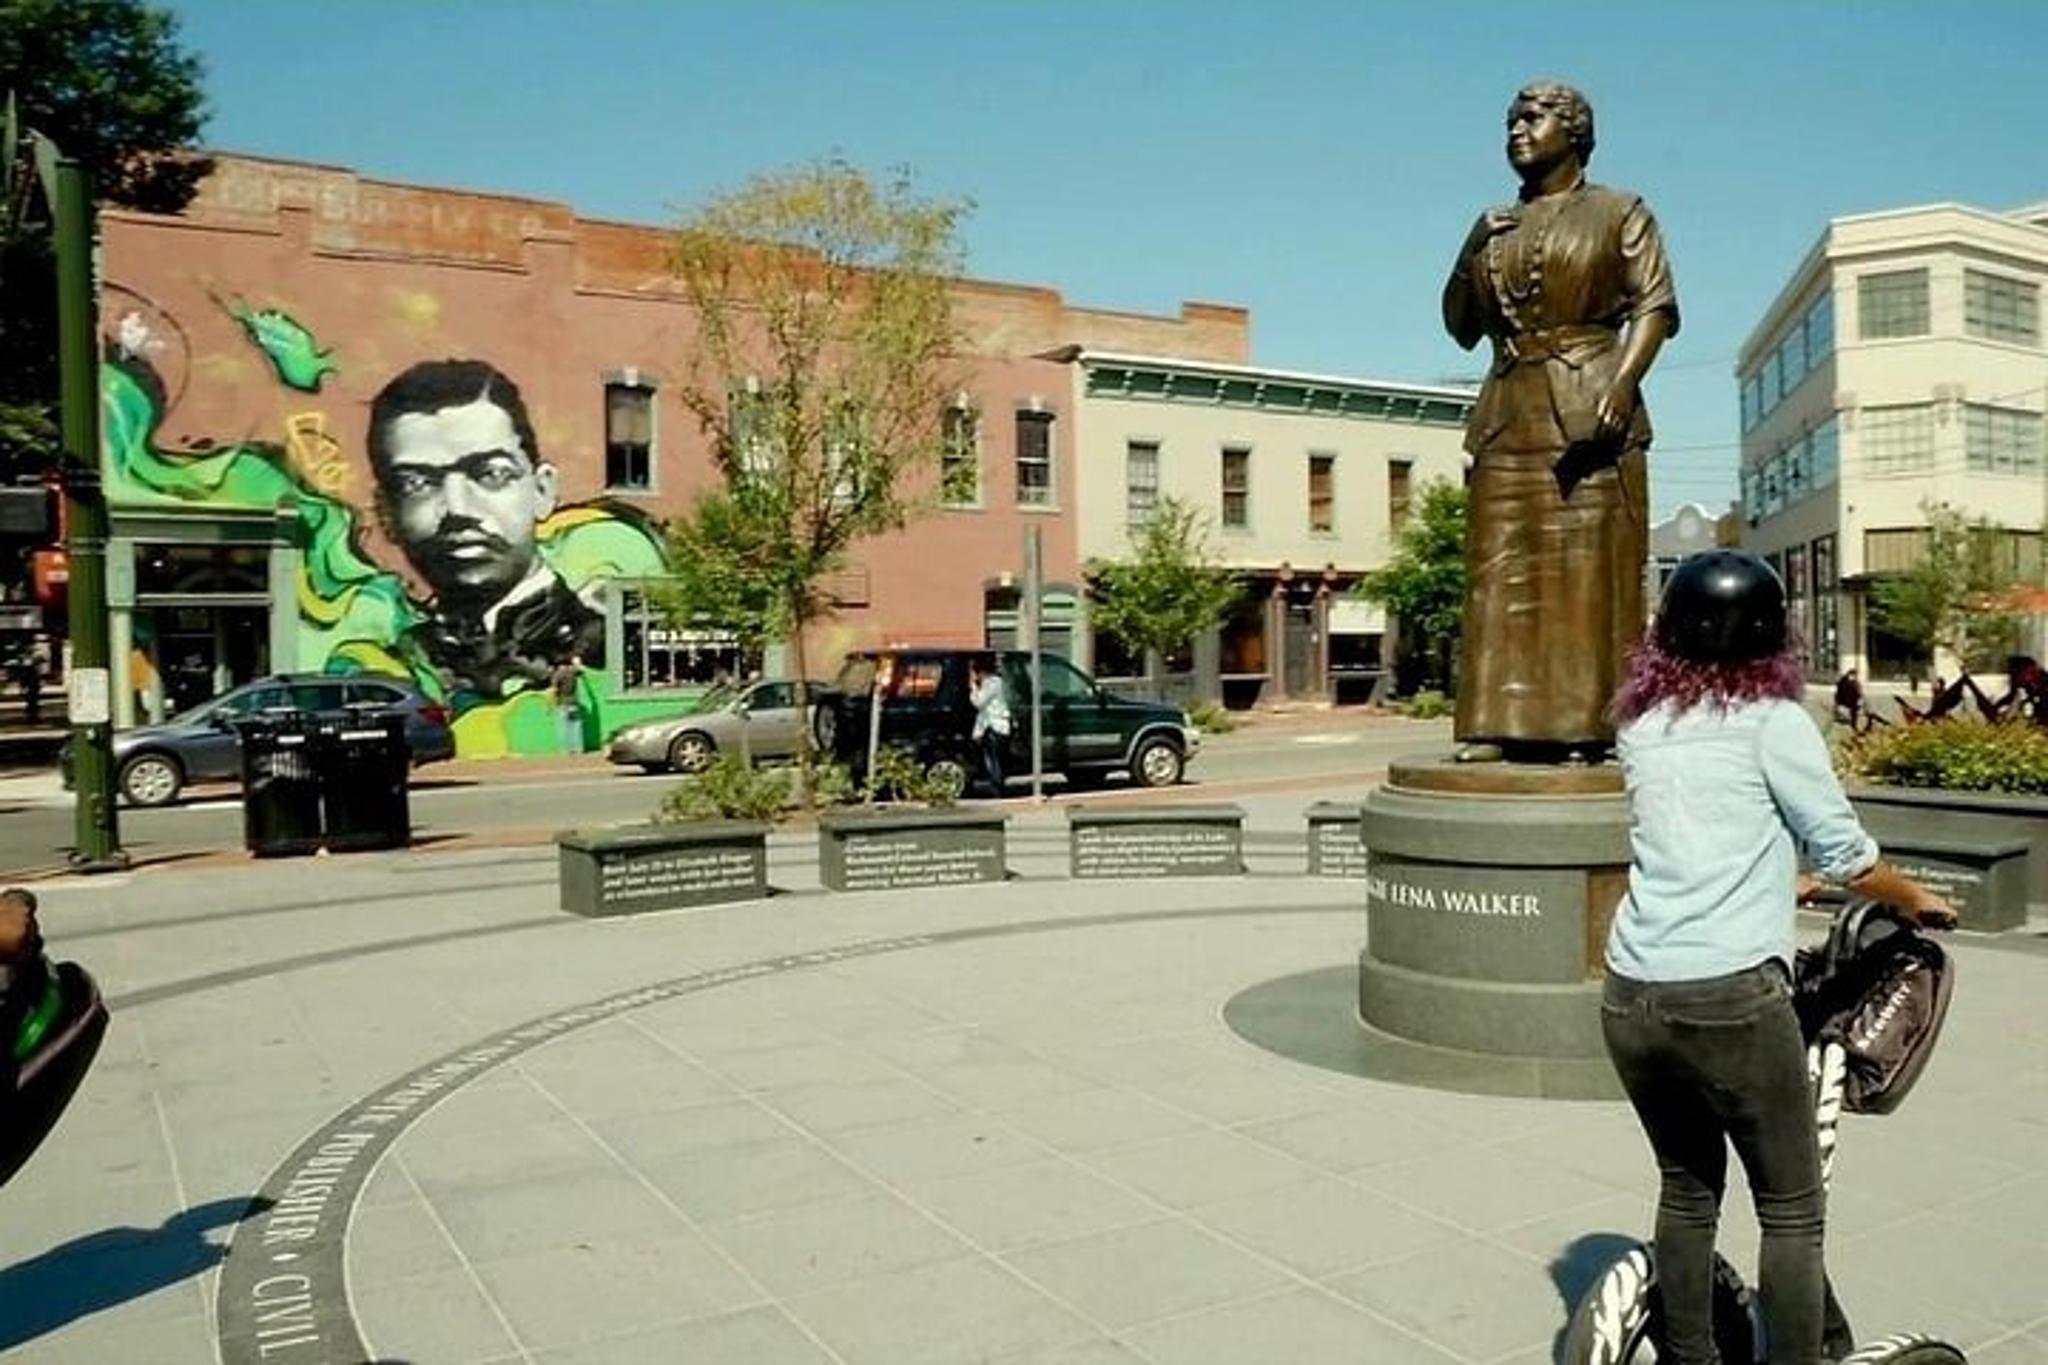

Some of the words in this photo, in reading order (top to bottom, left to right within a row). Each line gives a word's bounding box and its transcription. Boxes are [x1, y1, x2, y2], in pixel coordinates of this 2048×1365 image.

[1391, 884, 1436, 910] LENA
[1442, 891, 1541, 916] WALKER
[261, 1132, 376, 1246] PUBLISHER
[252, 1273, 320, 1359] CIVIL
